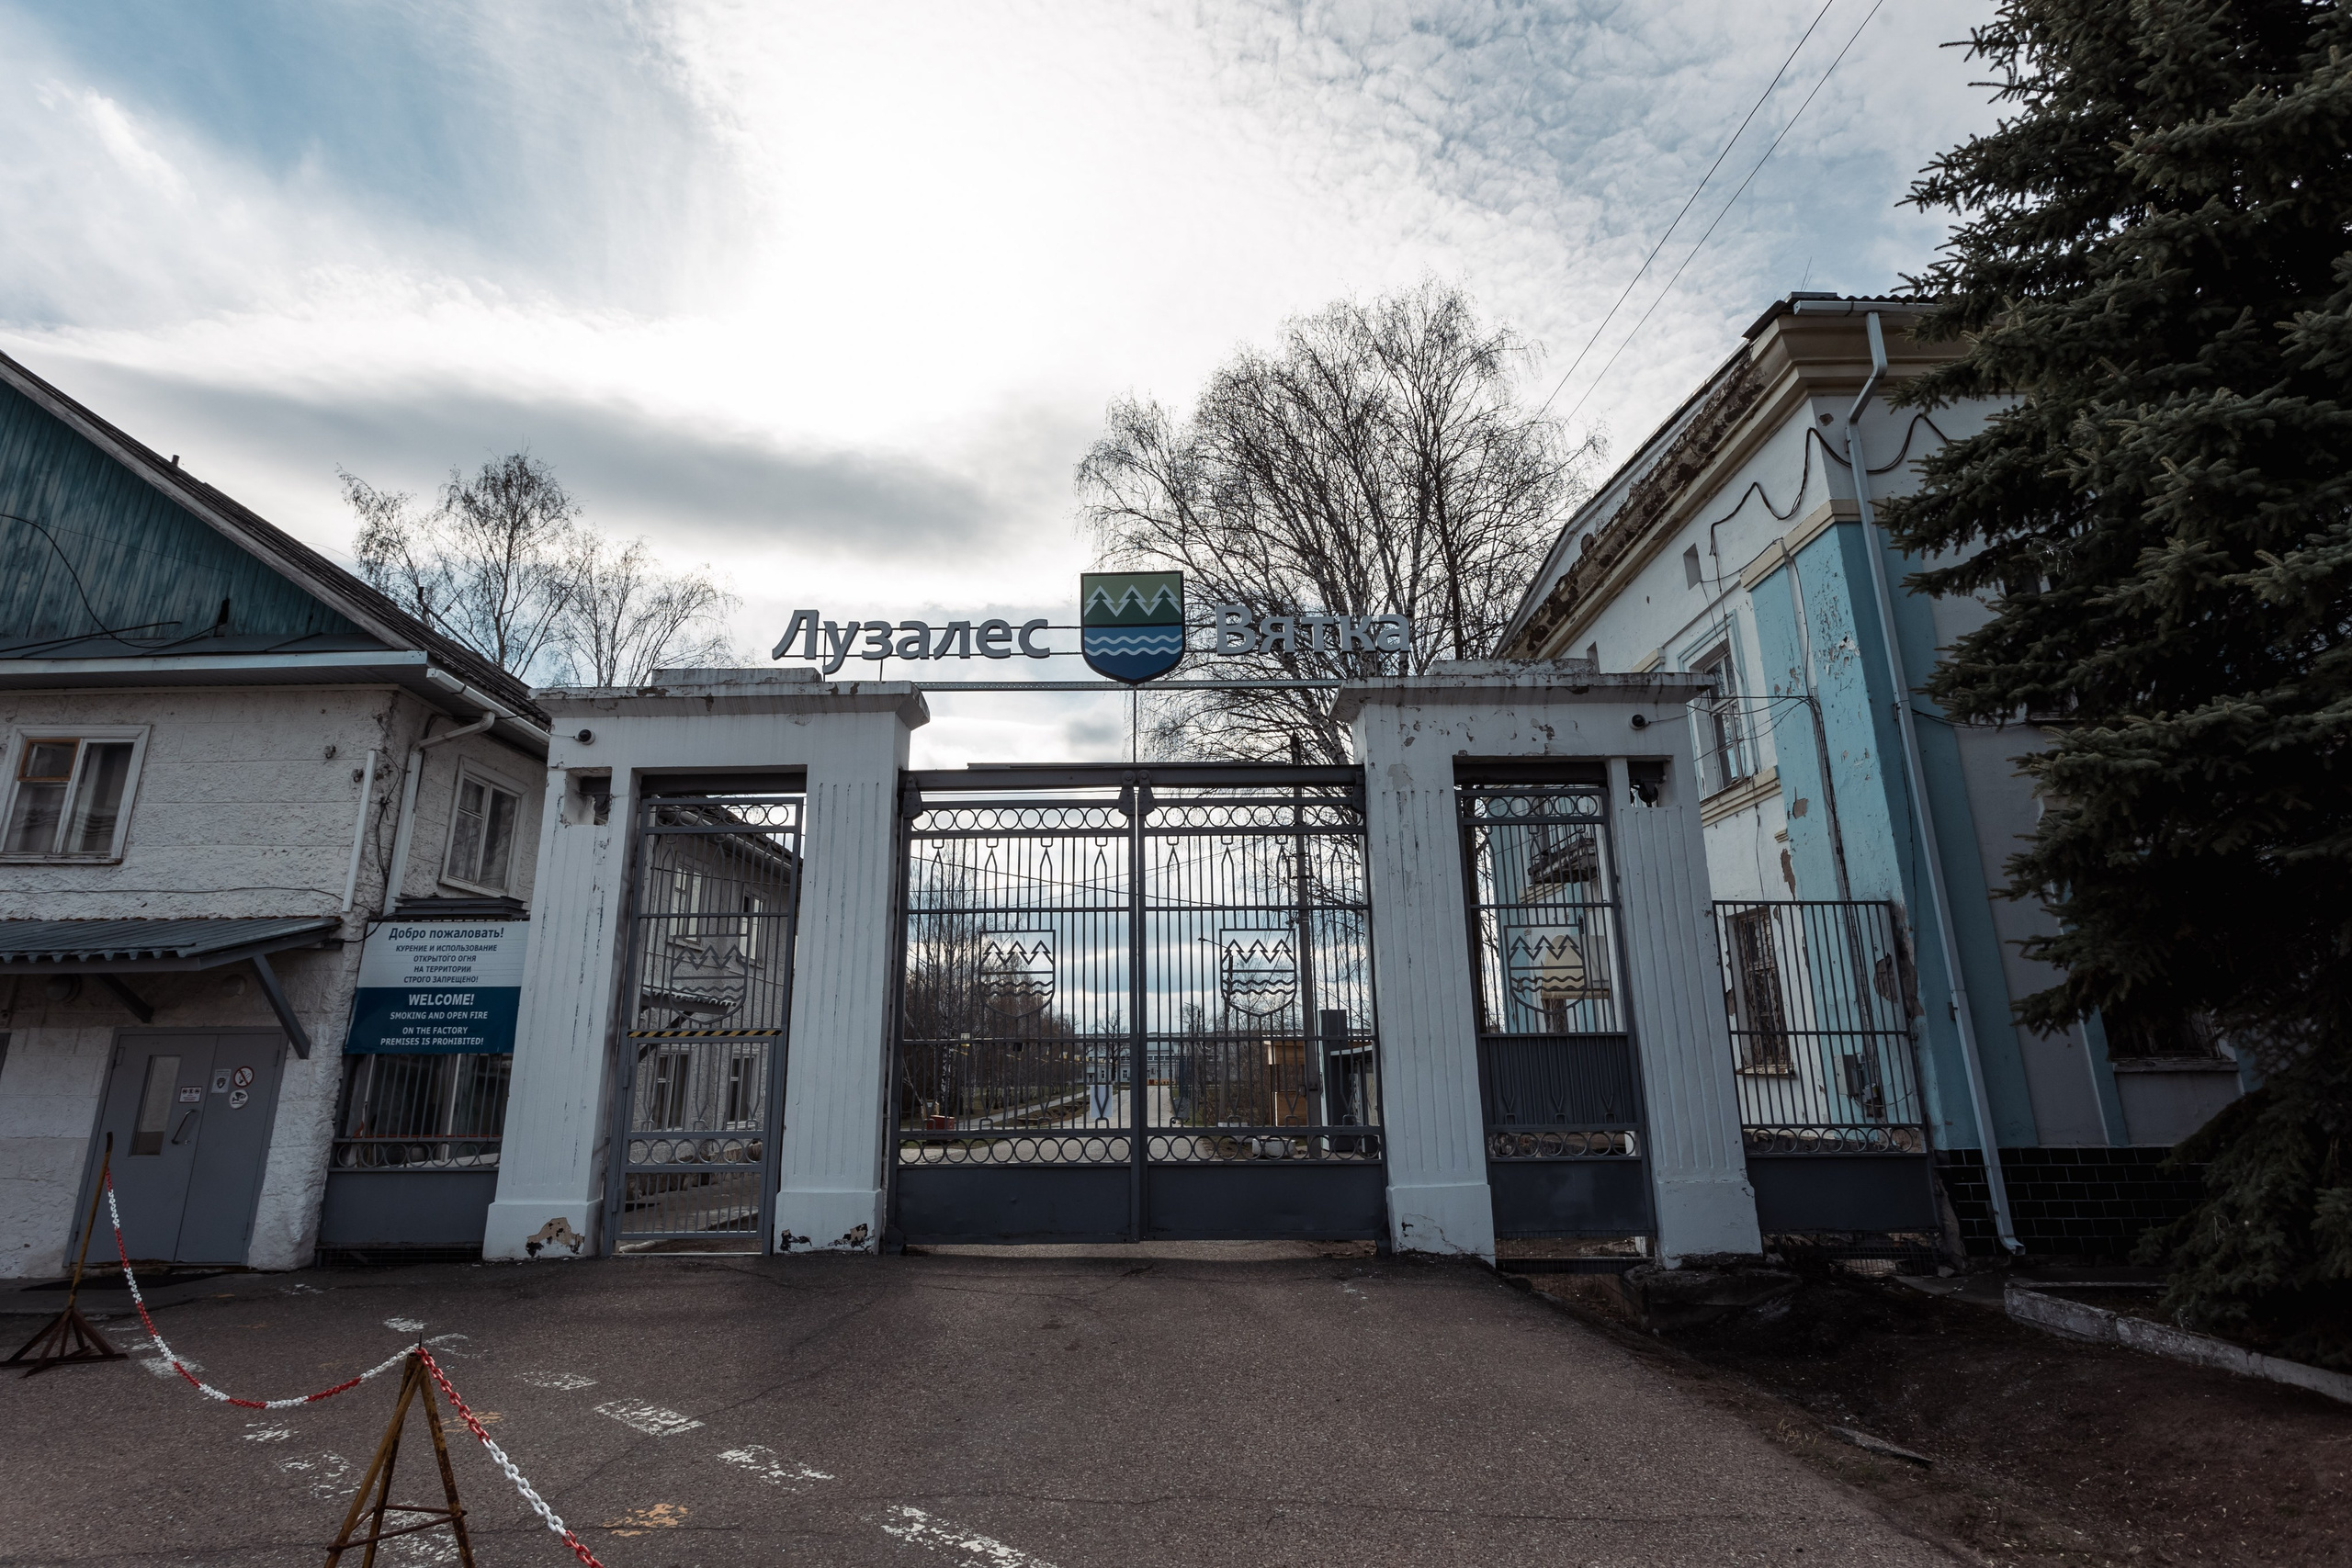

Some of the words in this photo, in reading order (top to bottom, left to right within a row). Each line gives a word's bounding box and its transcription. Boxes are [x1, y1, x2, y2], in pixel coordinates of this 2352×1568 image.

[772, 608, 1051, 673] Лузалес
[1214, 604, 1412, 656] Вятка
[389, 928, 425, 941] Добро
[429, 927, 504, 939] пожаловать!
[432, 976, 478, 984] ЗАПРЕЩЕНО!
[409, 994, 475, 1006] WELCOME!
[390, 1011, 426, 1020] SMOKING
[428, 1011, 445, 1020] AND
[433, 1026, 469, 1034] FACTORY
[432, 1037, 484, 1045] PROHIBITED!
